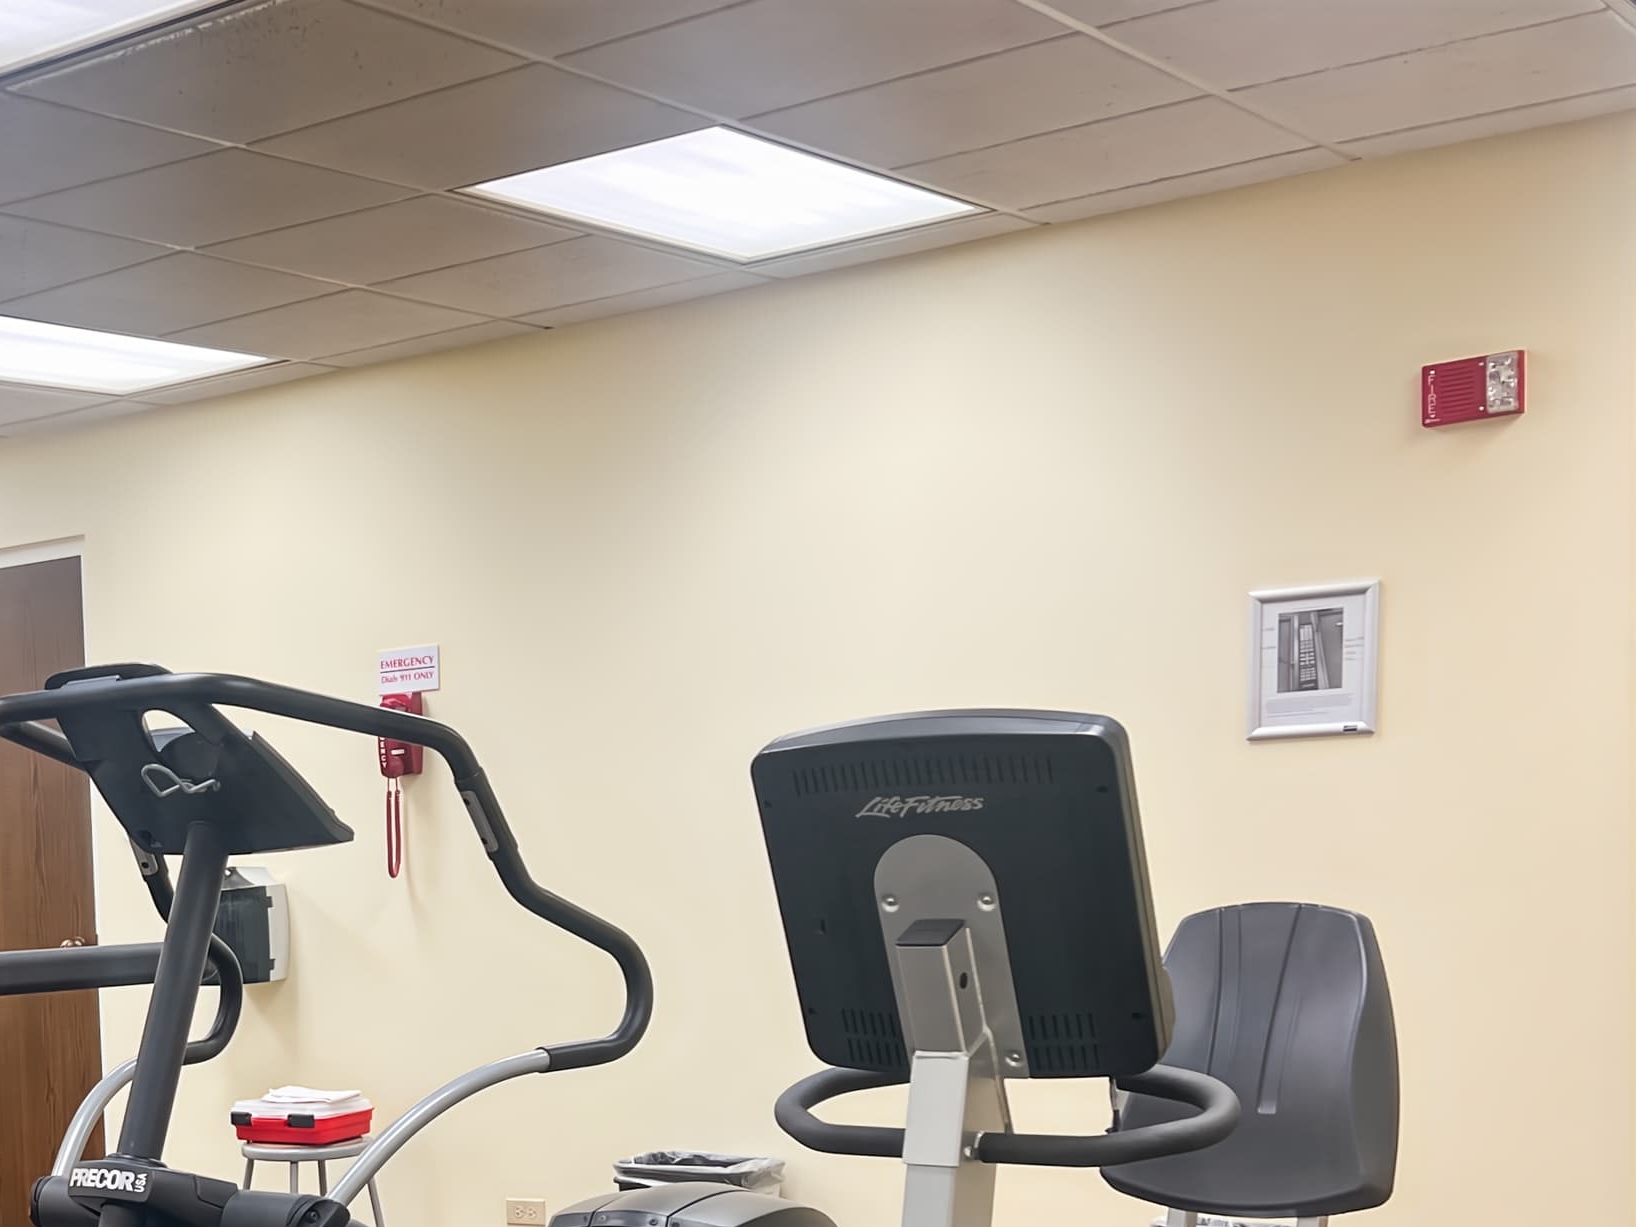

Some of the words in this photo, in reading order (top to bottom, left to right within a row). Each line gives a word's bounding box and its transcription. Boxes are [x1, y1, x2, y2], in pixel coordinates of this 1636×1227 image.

[380, 655, 435, 670] EMERGENCY
[400, 673, 412, 681] 911
[413, 671, 435, 681] ONLY
[69, 1167, 135, 1192] PRECOR
[134, 1173, 148, 1193] USA
